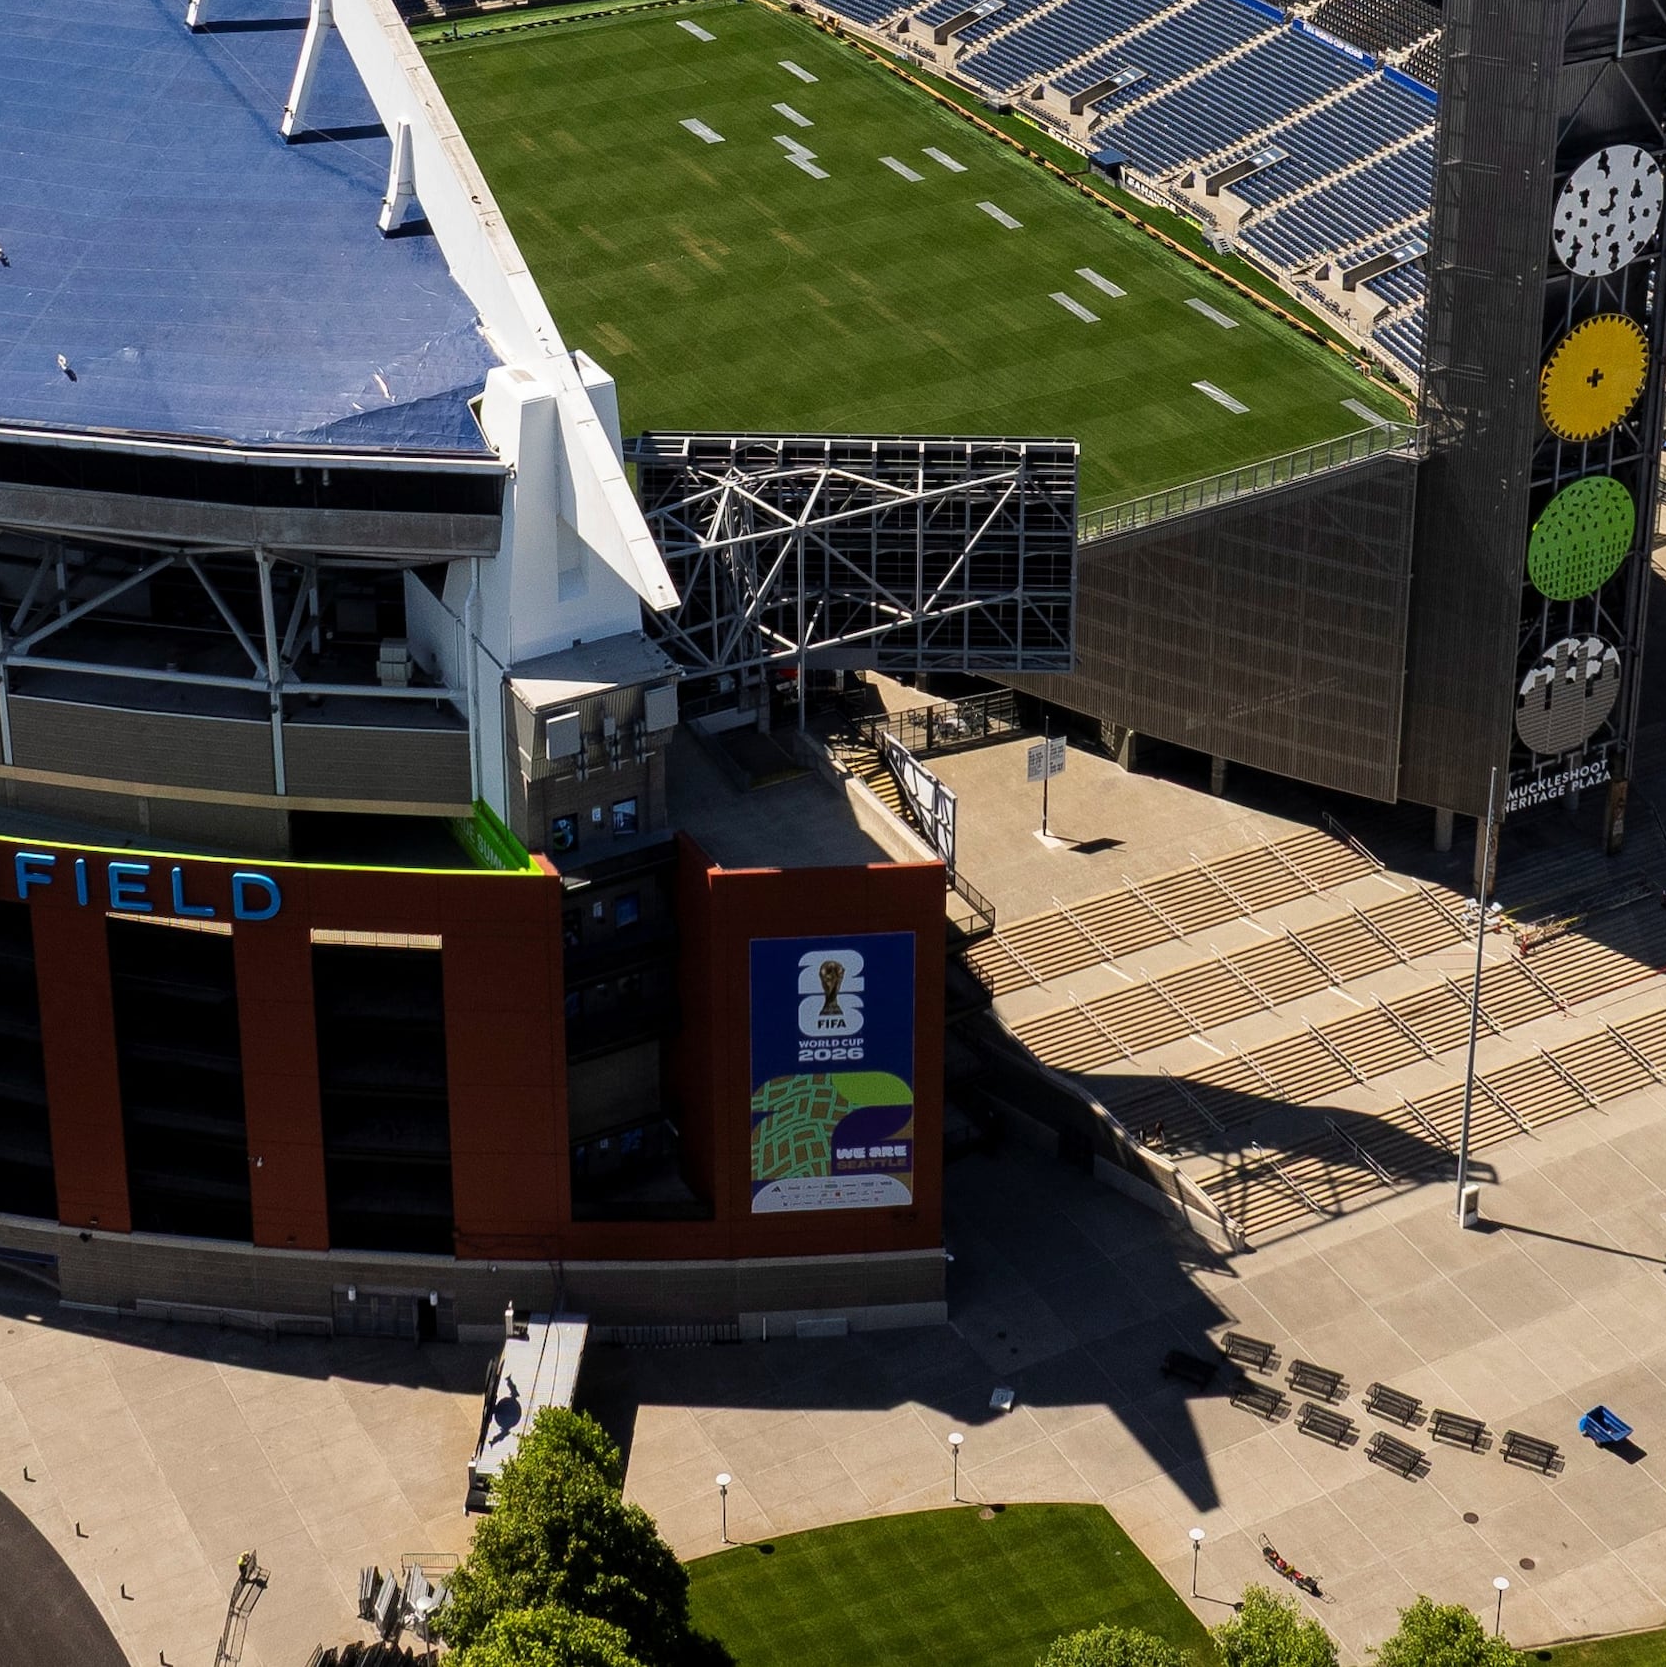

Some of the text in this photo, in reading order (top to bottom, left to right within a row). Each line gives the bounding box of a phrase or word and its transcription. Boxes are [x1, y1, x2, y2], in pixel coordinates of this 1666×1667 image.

[1127, 176, 1178, 212] EAHAWKS
[1507, 759, 1608, 800] MUCKLESHOOT
[1571, 770, 1612, 793] PLAZA
[15, 852, 282, 921] FIELD
[817, 1019, 846, 1029] FIFA
[798, 1038, 864, 1049] WORLD CUP
[798, 1048, 864, 1062] 2026
[837, 1145, 907, 1160] WE ARE
[837, 1158, 907, 1171] SEATTLE
